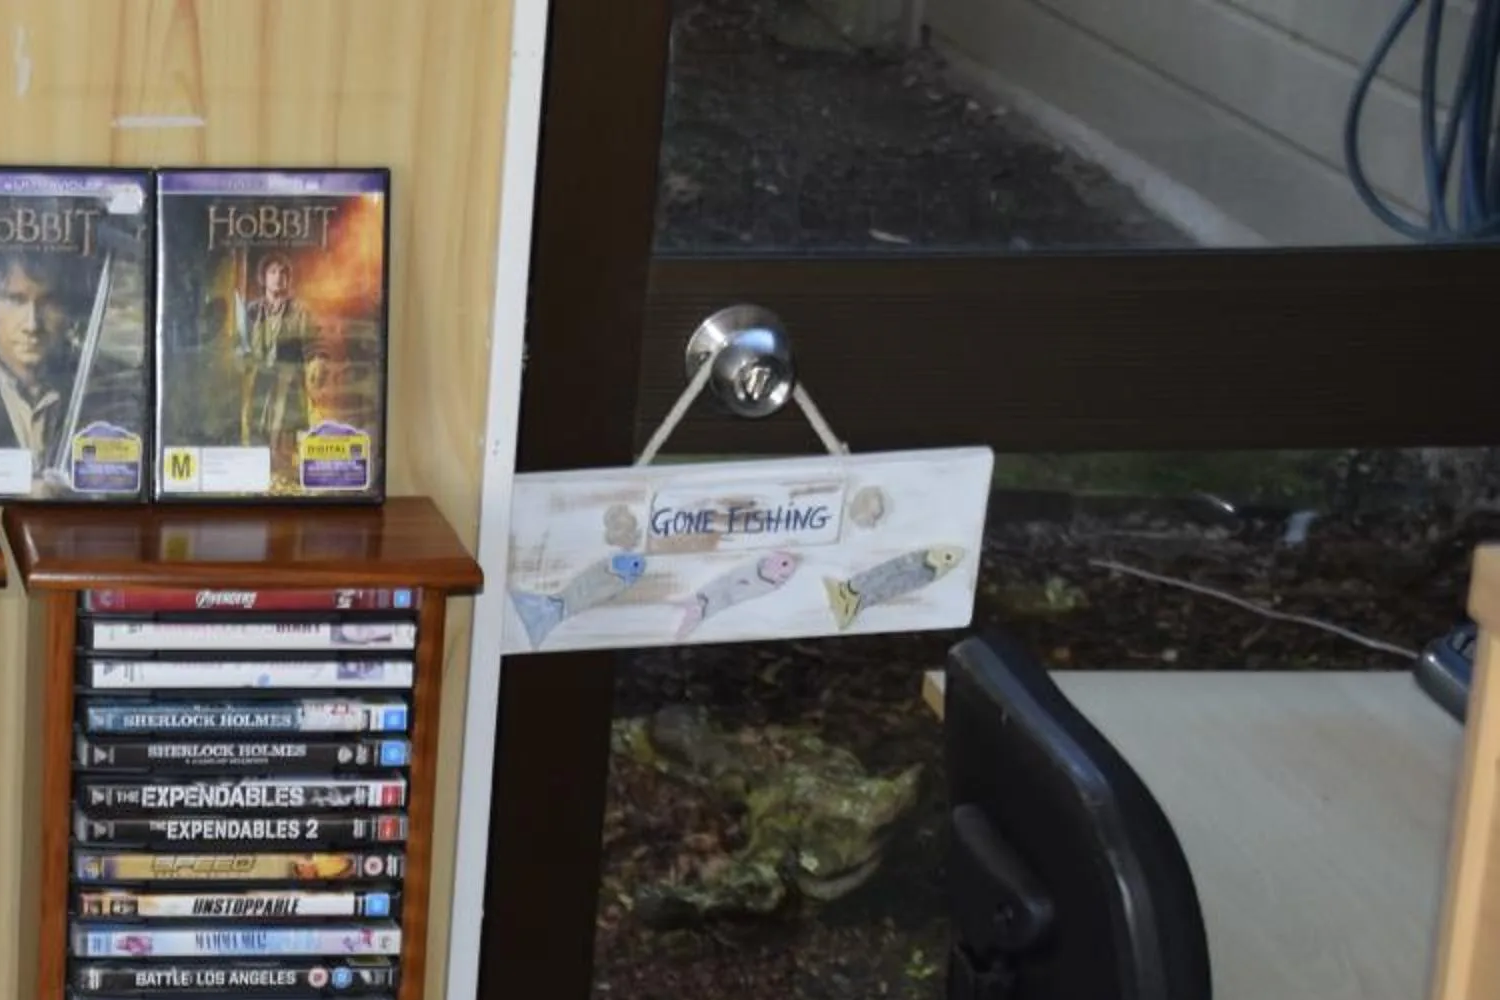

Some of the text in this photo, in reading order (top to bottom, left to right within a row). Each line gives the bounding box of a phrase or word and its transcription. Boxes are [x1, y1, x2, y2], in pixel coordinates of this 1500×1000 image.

[170, 454, 192, 480] M
[650, 504, 716, 536] GONE
[123, 713, 292, 727] SHERLOCK HOLMES
[148, 744, 306, 758] SHERLOCK HOLMES
[116, 786, 305, 807] THE EXPENDABLES
[167, 820, 300, 840] EXPENDABLES
[305, 819, 319, 836] 2
[192, 897, 300, 915] UNSTOPPABLE
[196, 970, 296, 985] LOS ANGELES
